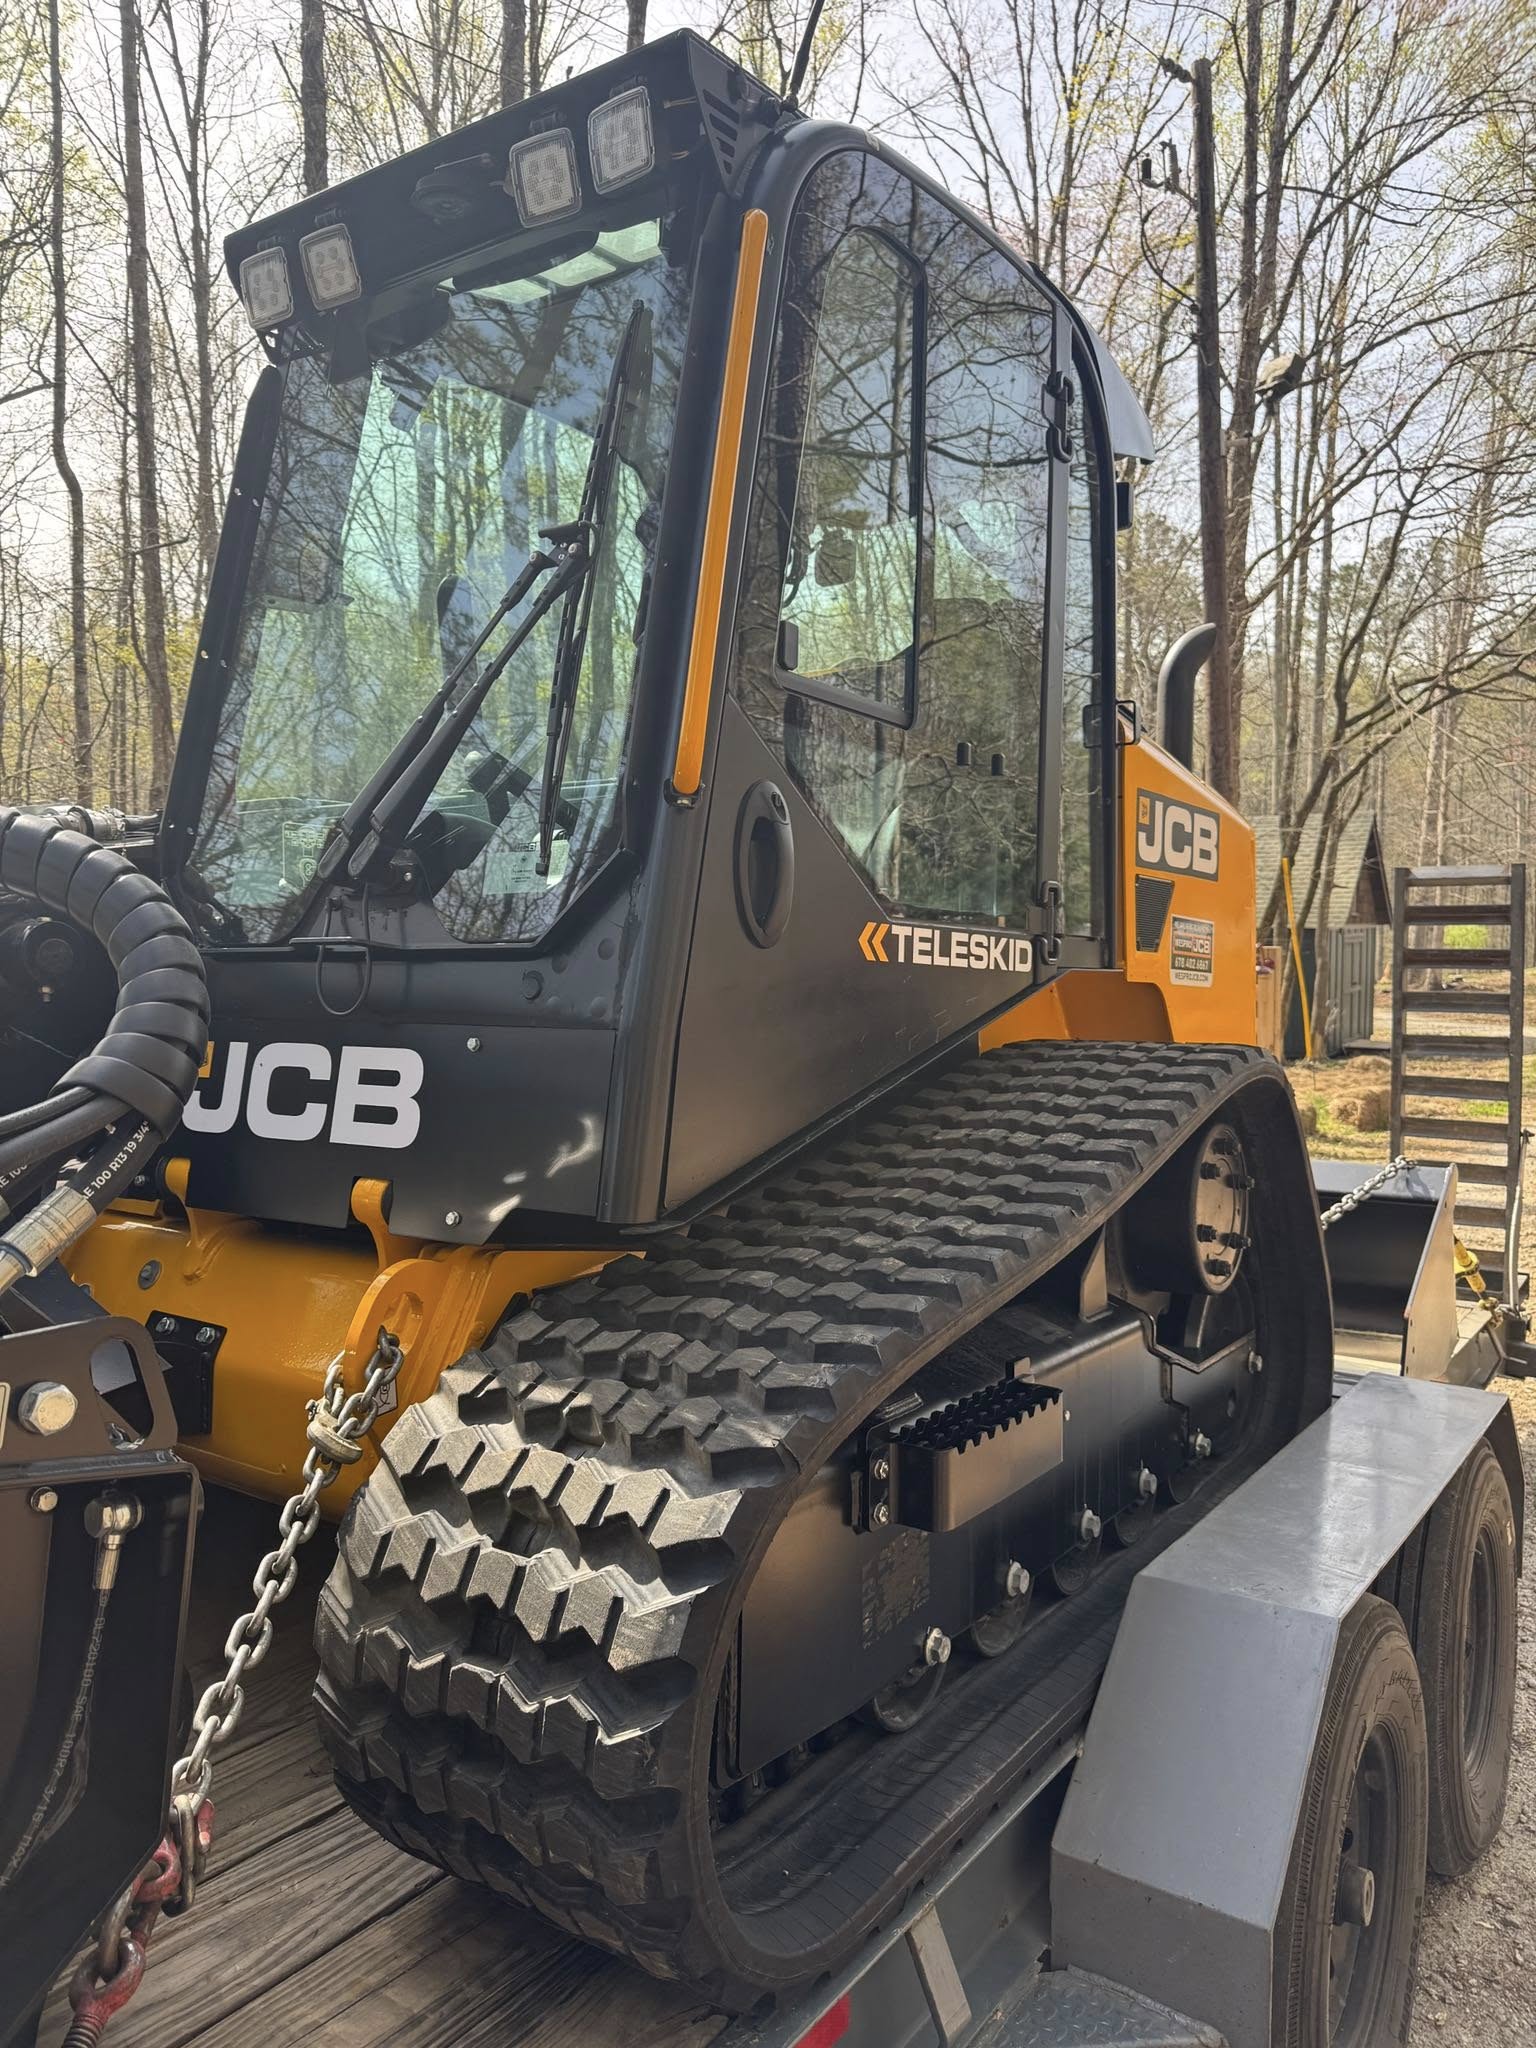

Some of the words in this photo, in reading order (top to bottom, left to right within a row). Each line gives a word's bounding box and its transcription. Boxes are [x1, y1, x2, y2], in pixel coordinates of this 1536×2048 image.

[1137, 800, 1218, 875] JCB
[891, 924, 1033, 973] TELESKID
[1193, 939, 1210, 954] JCB
[181, 1041, 425, 1149] JCB
[9, 1163, 28, 1179] 10
[91, 1169, 112, 1190] 100
[109, 1151, 128, 1173] R13
[123, 1140, 138, 1154] 19
[133, 1120, 149, 1142] 3/4"
[71, 1695, 88, 1721] SAE
